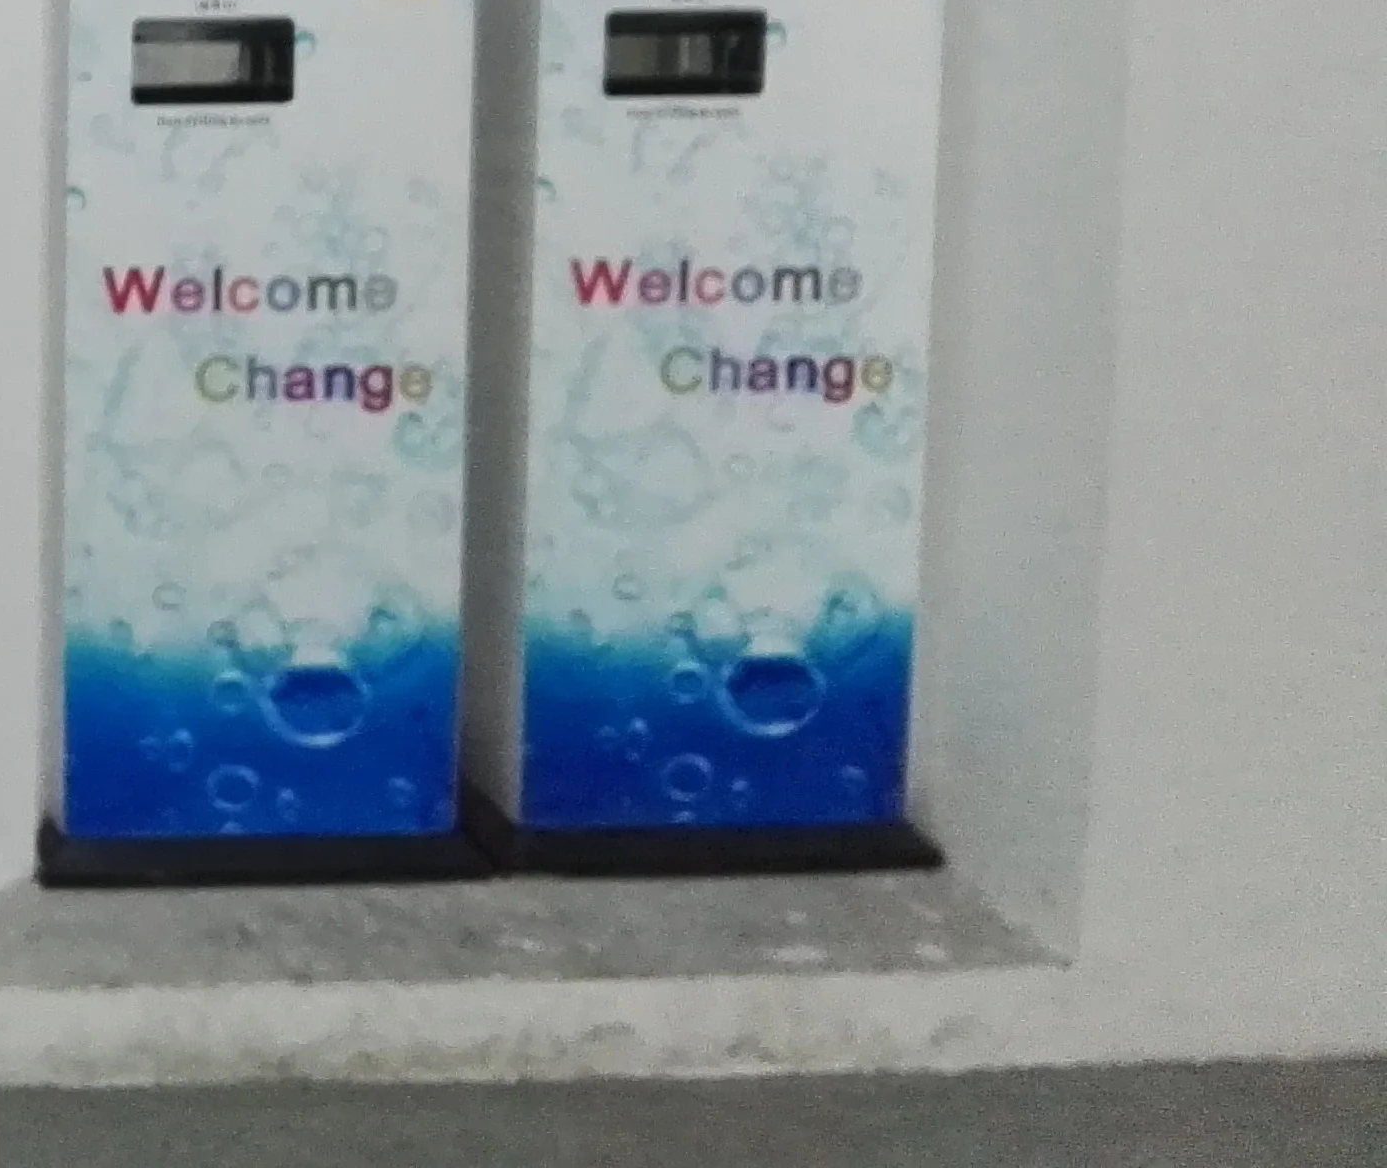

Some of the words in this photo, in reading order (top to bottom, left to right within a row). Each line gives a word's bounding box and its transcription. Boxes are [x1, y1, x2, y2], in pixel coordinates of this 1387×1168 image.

[103, 264, 398, 316] Welcome
[571, 258, 863, 308] Welcome
[195, 353, 434, 415] Change
[660, 345, 895, 403] Change
